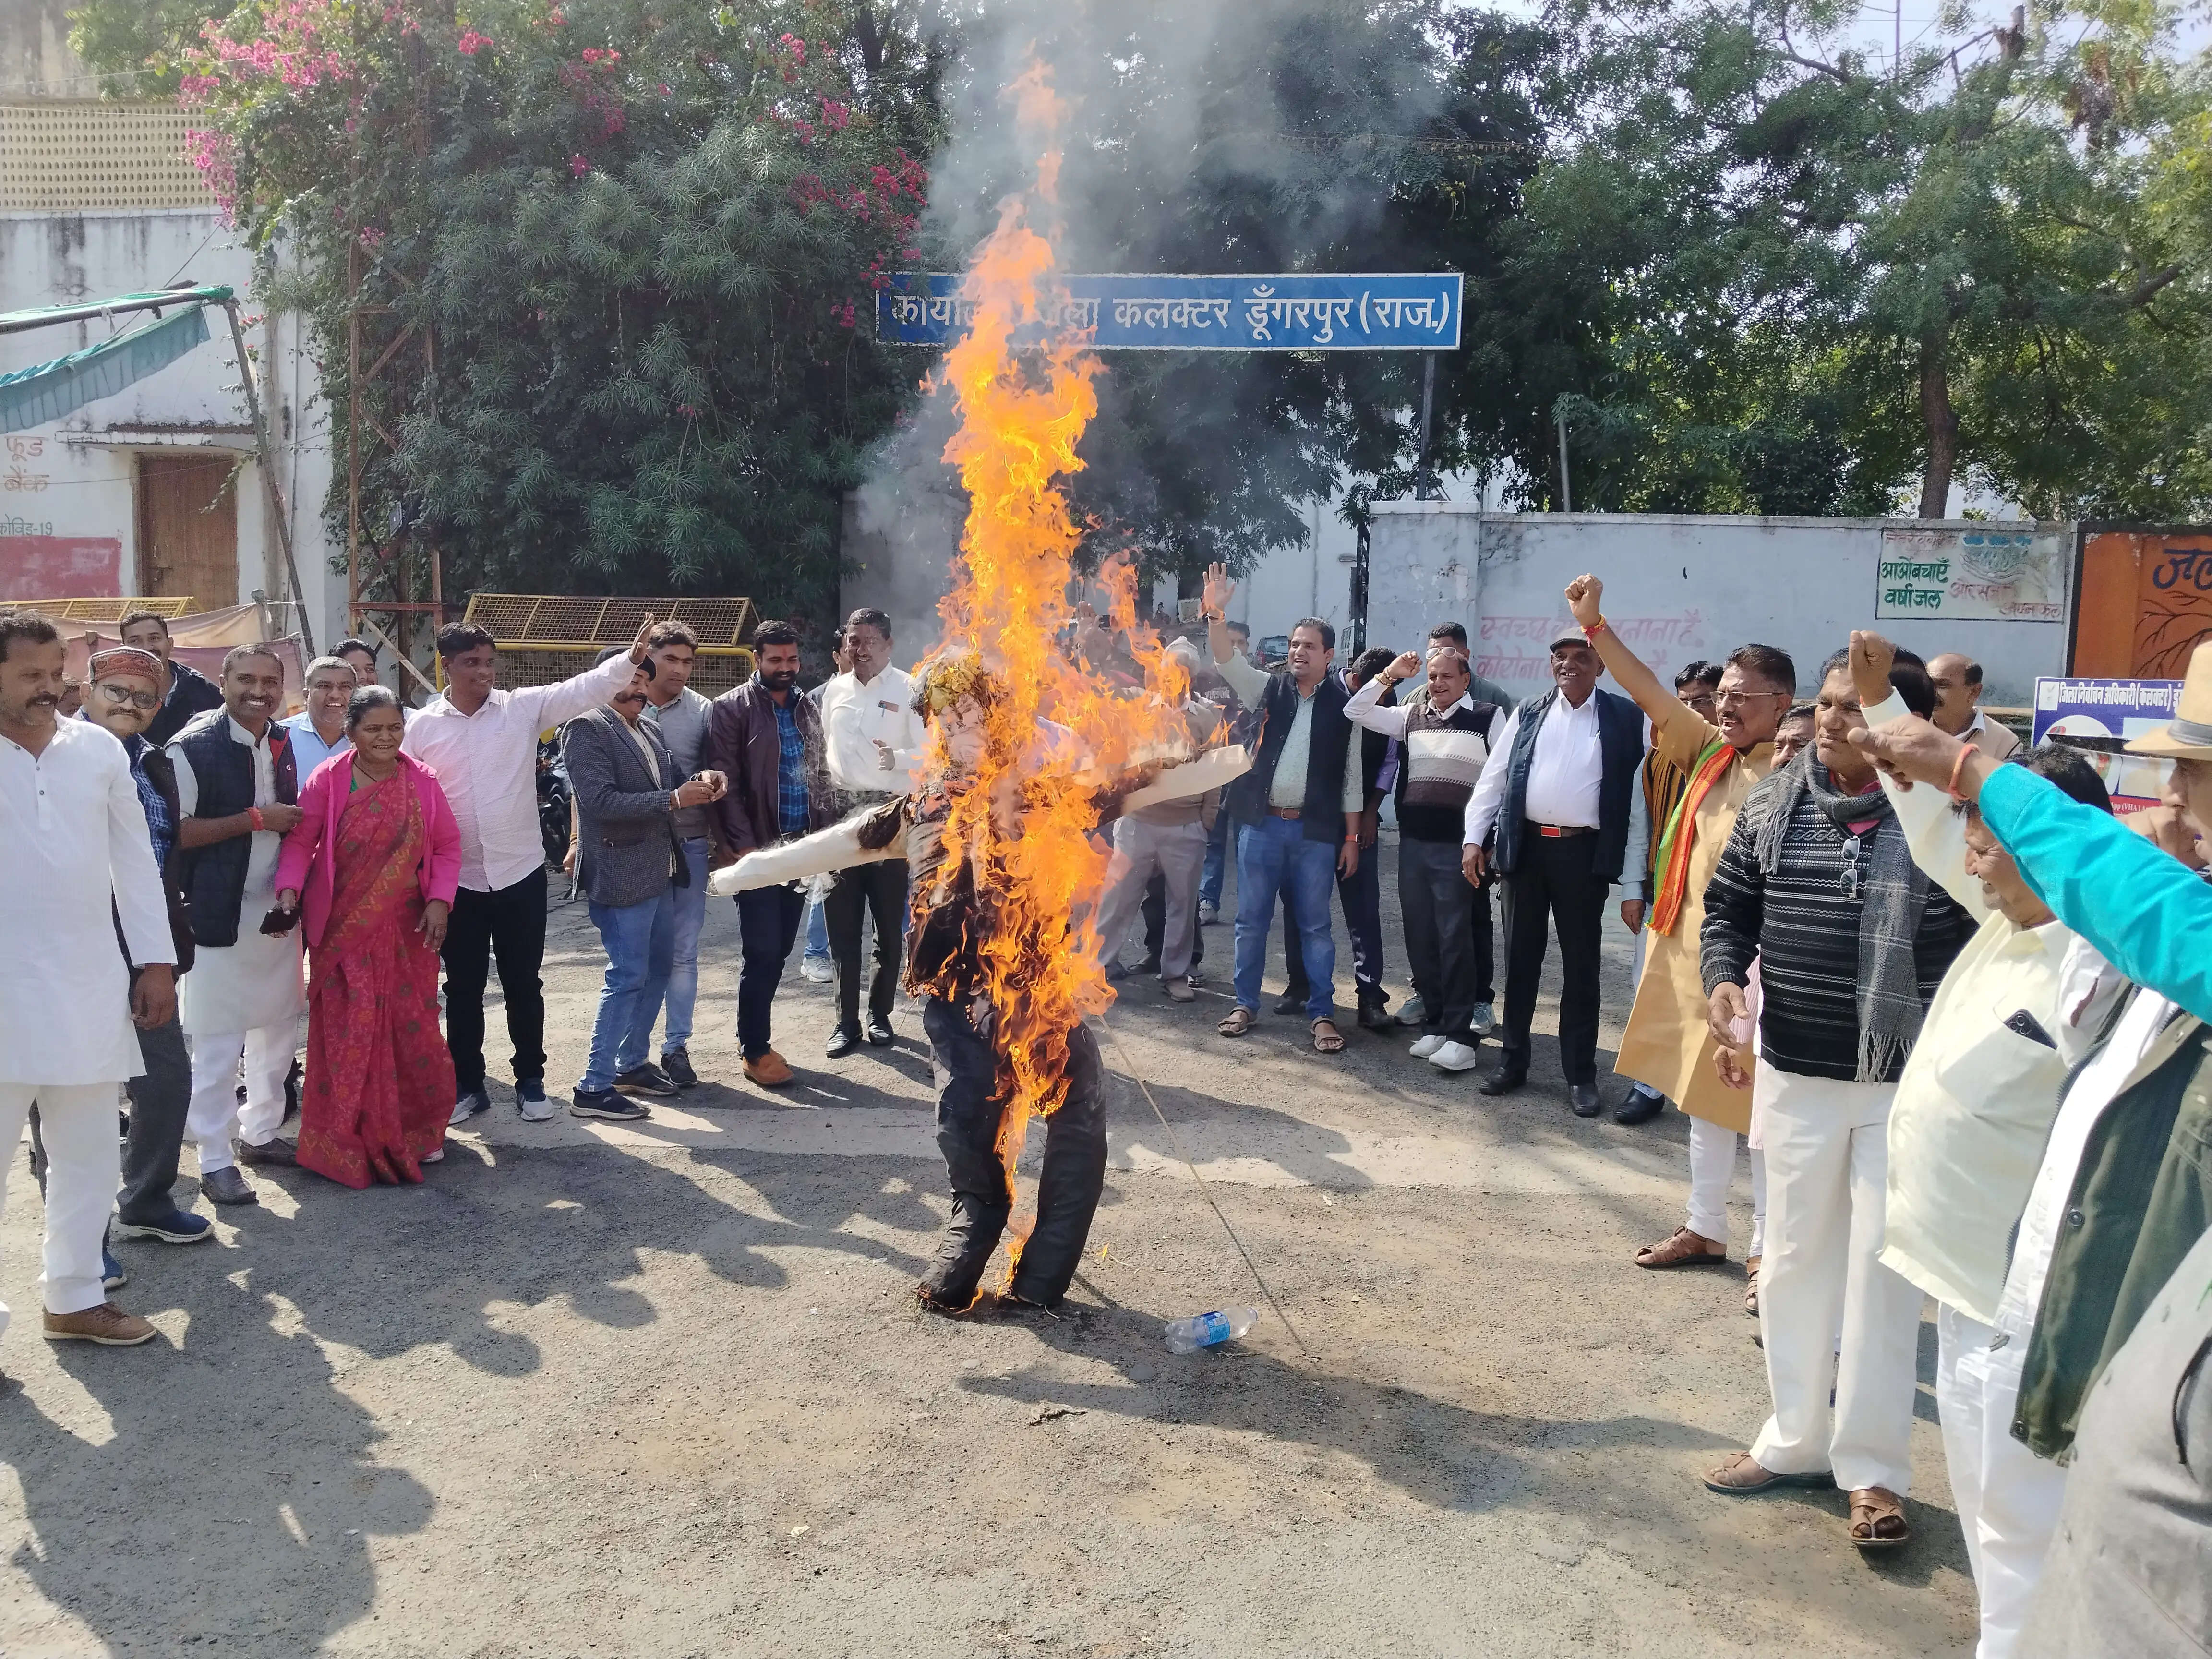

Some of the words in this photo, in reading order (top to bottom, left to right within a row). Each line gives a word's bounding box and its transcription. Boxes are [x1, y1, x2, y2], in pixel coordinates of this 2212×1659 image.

[1113, 298, 1232, 329] कलक्टर
[1243, 284, 1354, 343] डूँगरपुर
[1359, 291, 1449, 334] (राज.)
[1476, 644, 1545, 680] कोरोना
[2058, 681, 2078, 703] जिला
[2077, 681, 2104, 704] निर्वाचन
[2104, 682, 2136, 705] अधिकारी
